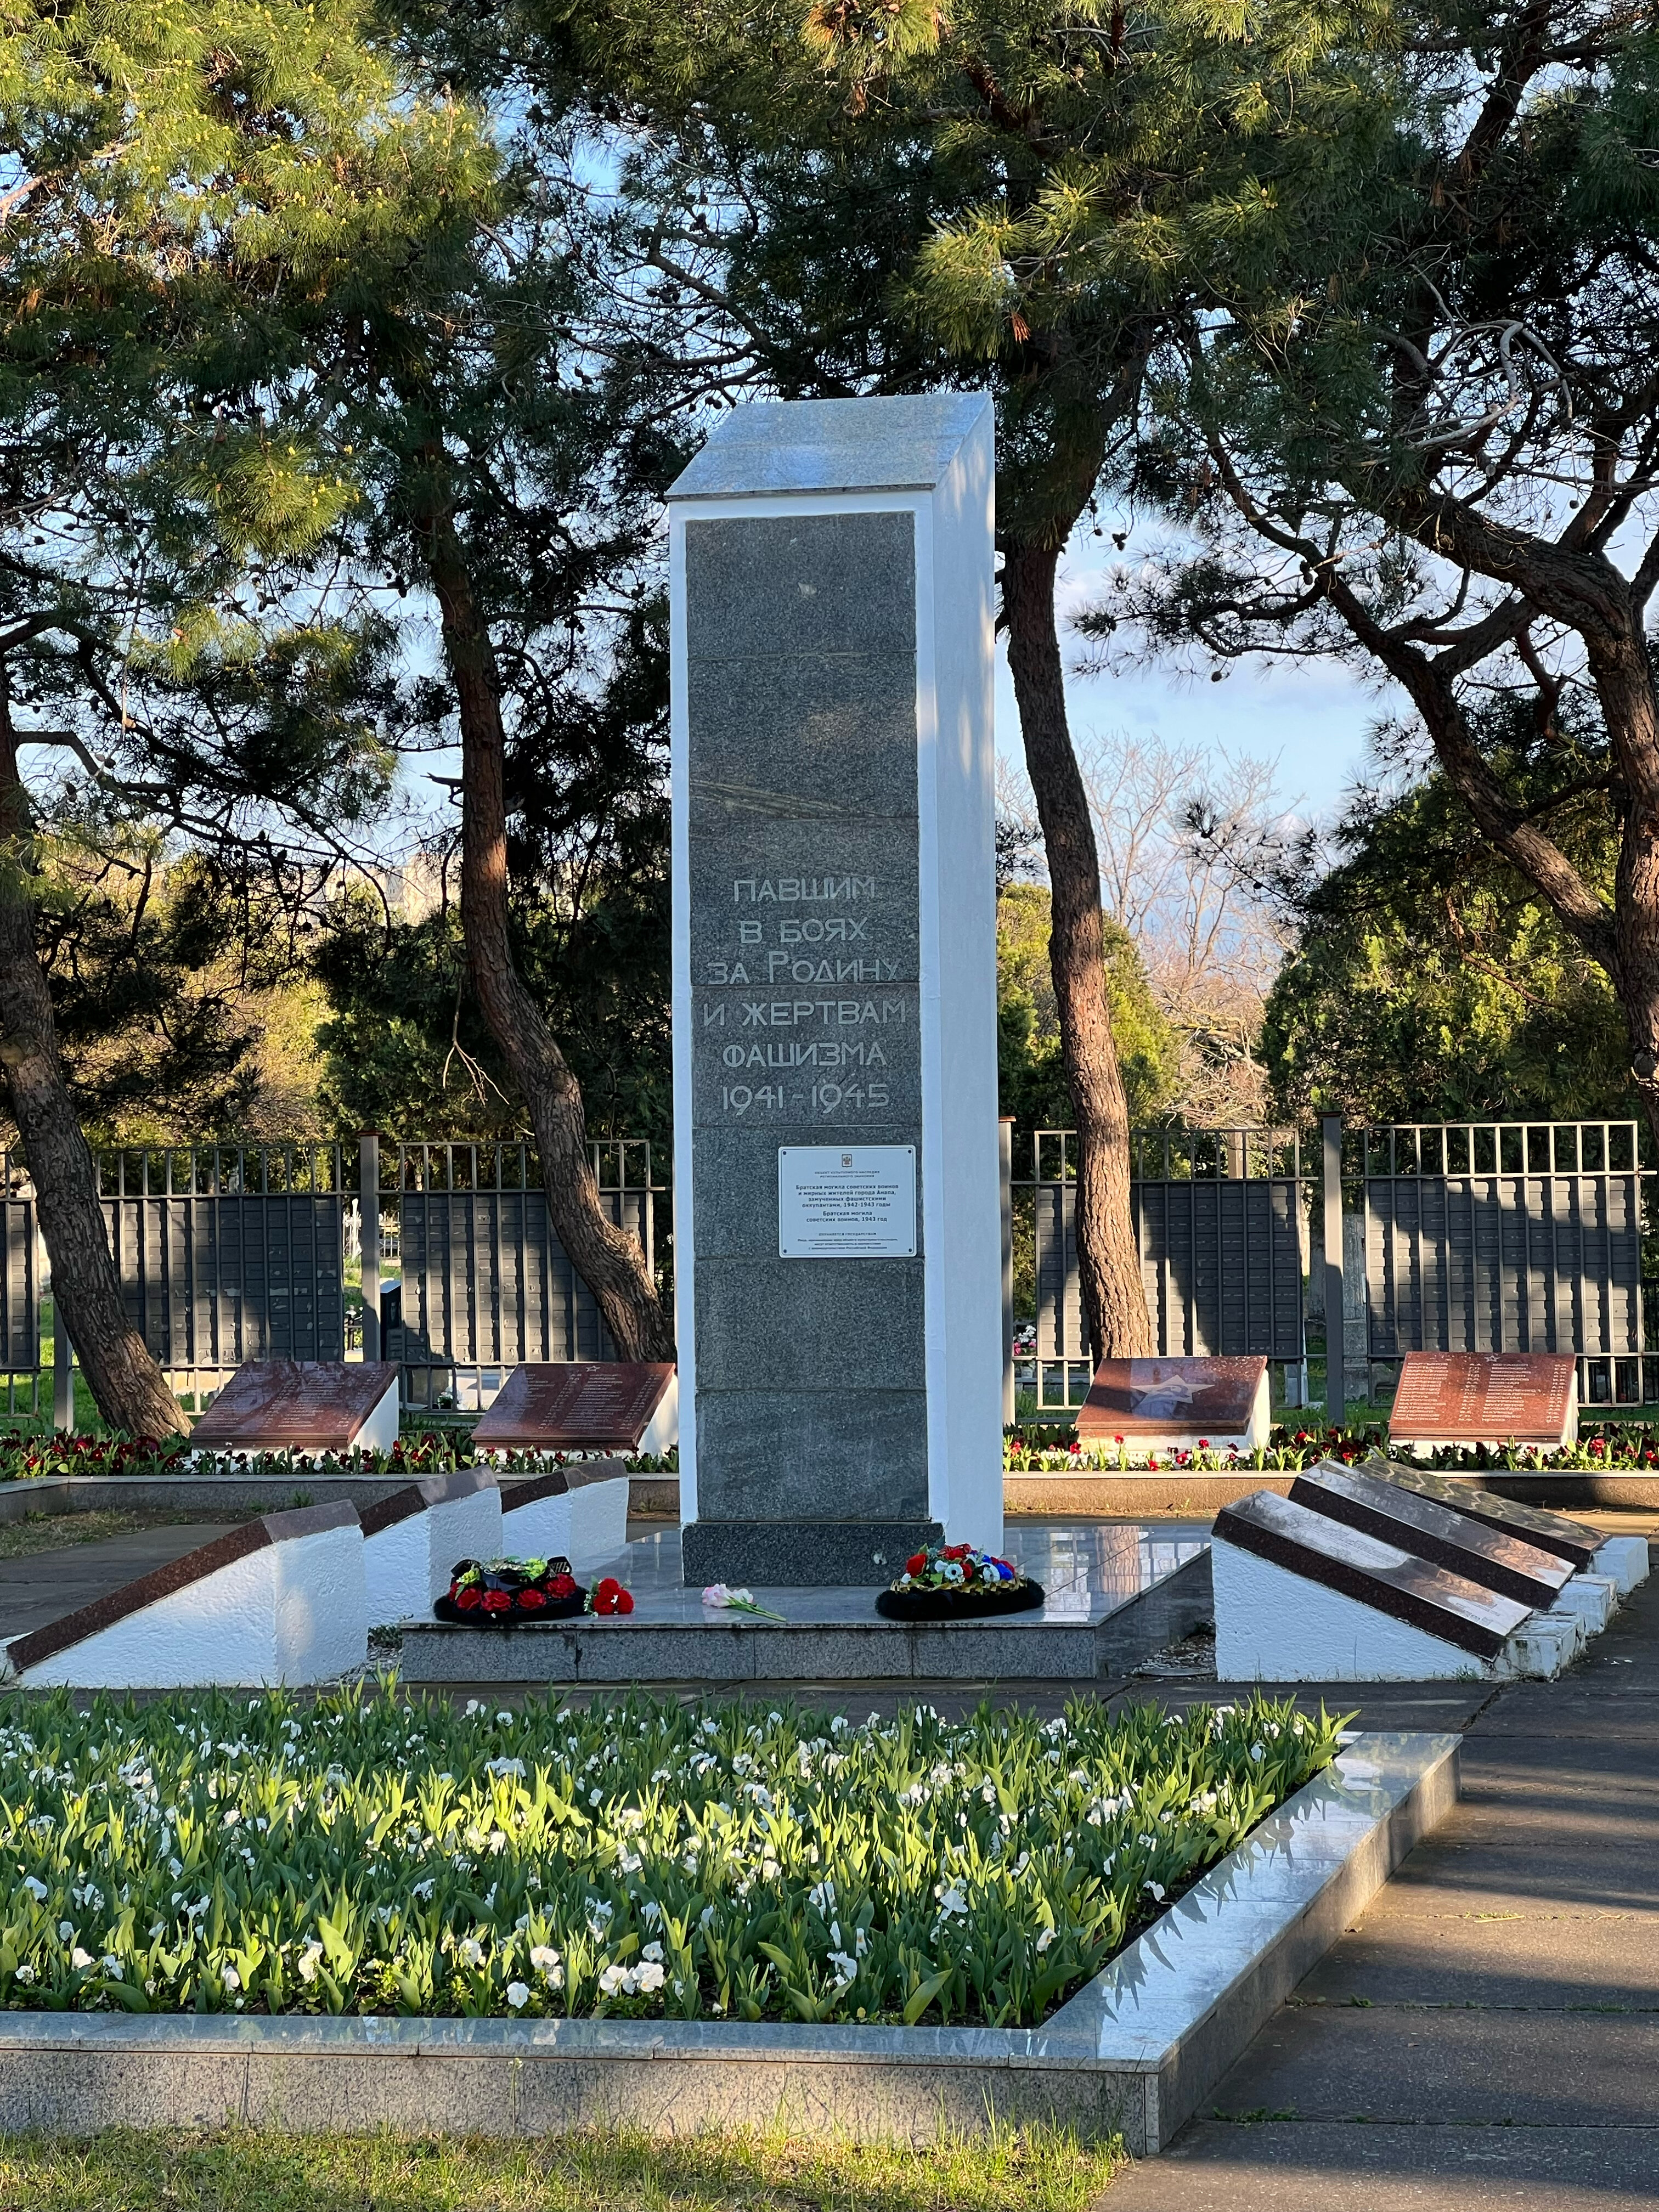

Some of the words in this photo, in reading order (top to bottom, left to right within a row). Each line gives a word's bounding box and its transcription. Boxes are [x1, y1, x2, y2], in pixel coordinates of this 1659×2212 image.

[734, 877, 876, 902] ПАВШИМ
[740, 920, 762, 944] В
[780, 917, 868, 942] БОЯХ
[708, 962, 750, 985] ЗА
[769, 951, 901, 983] РОДИНУ
[703, 1003, 725, 1027] И
[742, 1000, 906, 1026] ЖЕРТВАМ
[723, 1042, 887, 1068] ФАШИЗМА
